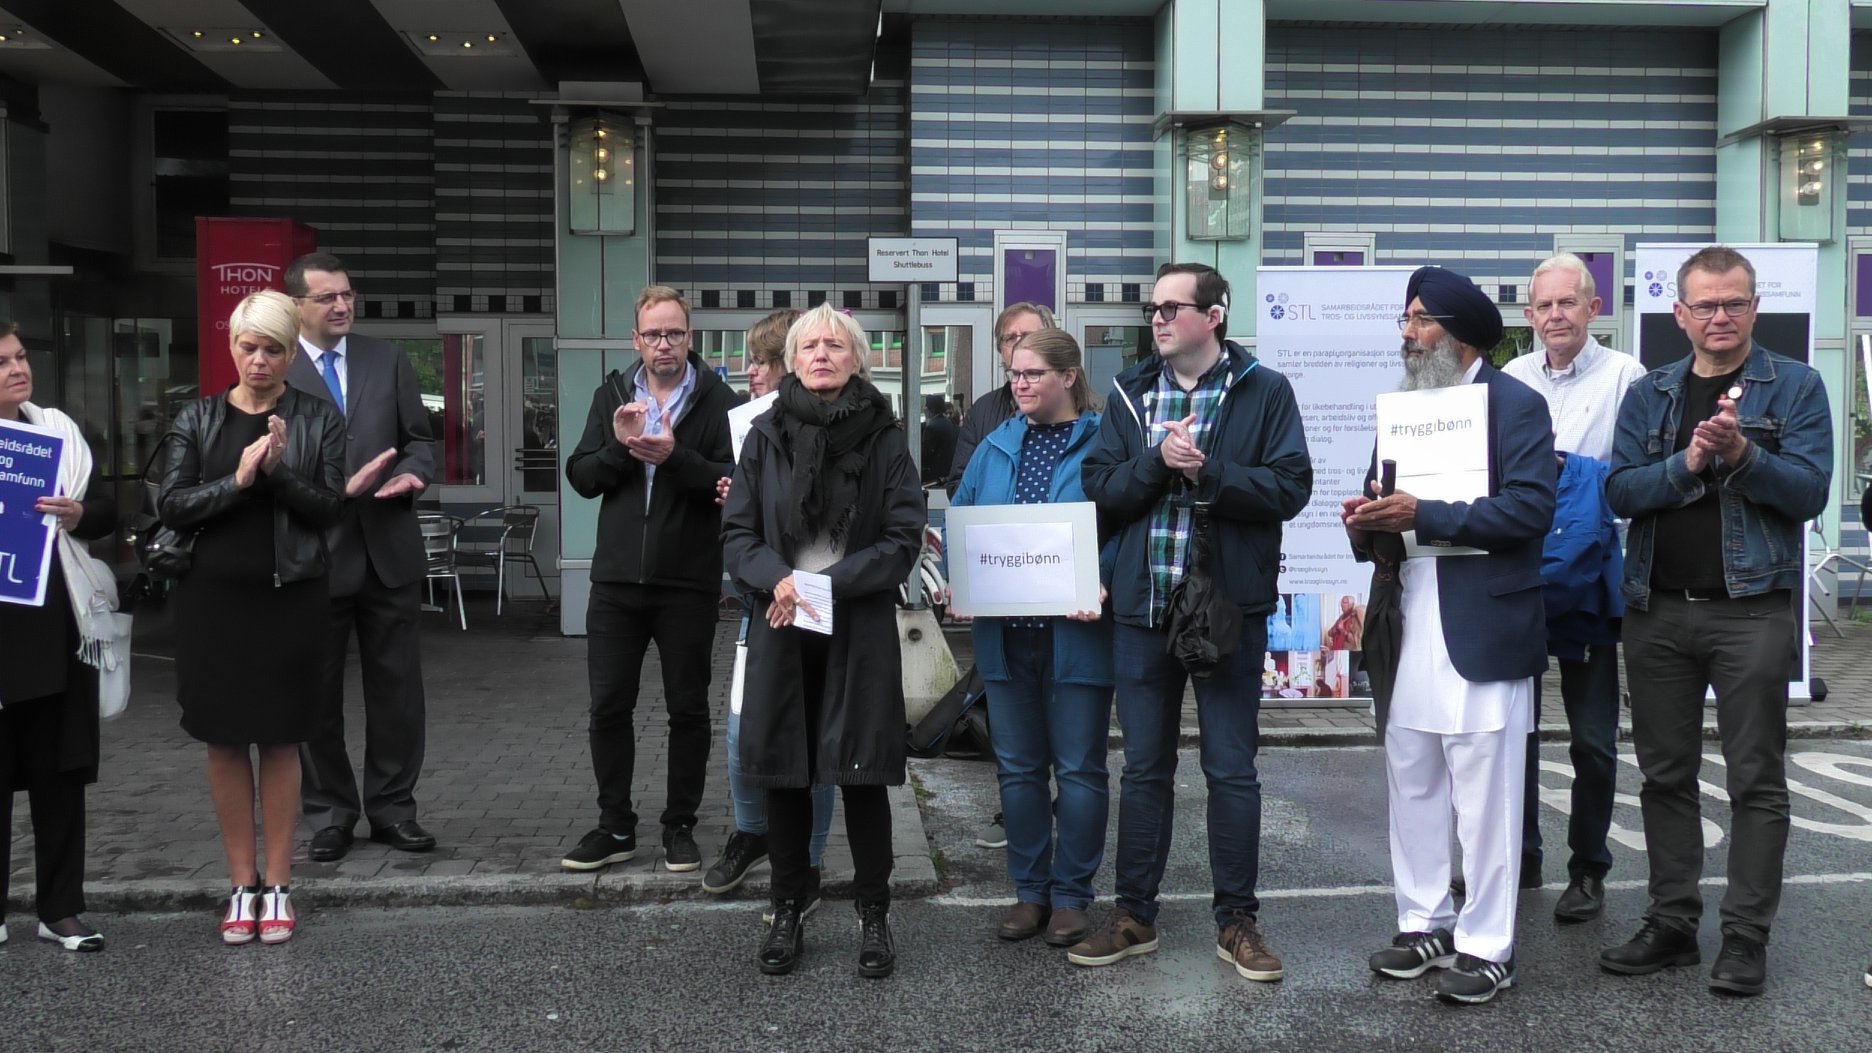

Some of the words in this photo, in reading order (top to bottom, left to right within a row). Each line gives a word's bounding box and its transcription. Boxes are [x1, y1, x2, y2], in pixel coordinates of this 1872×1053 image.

[876, 249, 909, 257] Reservert
[912, 249, 929, 257] Thon
[931, 249, 949, 257] Hotel
[893, 261, 933, 269] Shuttlebuss
[211, 262, 281, 283] THON
[1288, 304, 1316, 320] STL
[1344, 313, 1356, 321] OG
[1277, 349, 1293, 358] STL
[1391, 418, 1472, 437] #tryggibønn
[980, 552, 1061, 568] #tryggibønn
